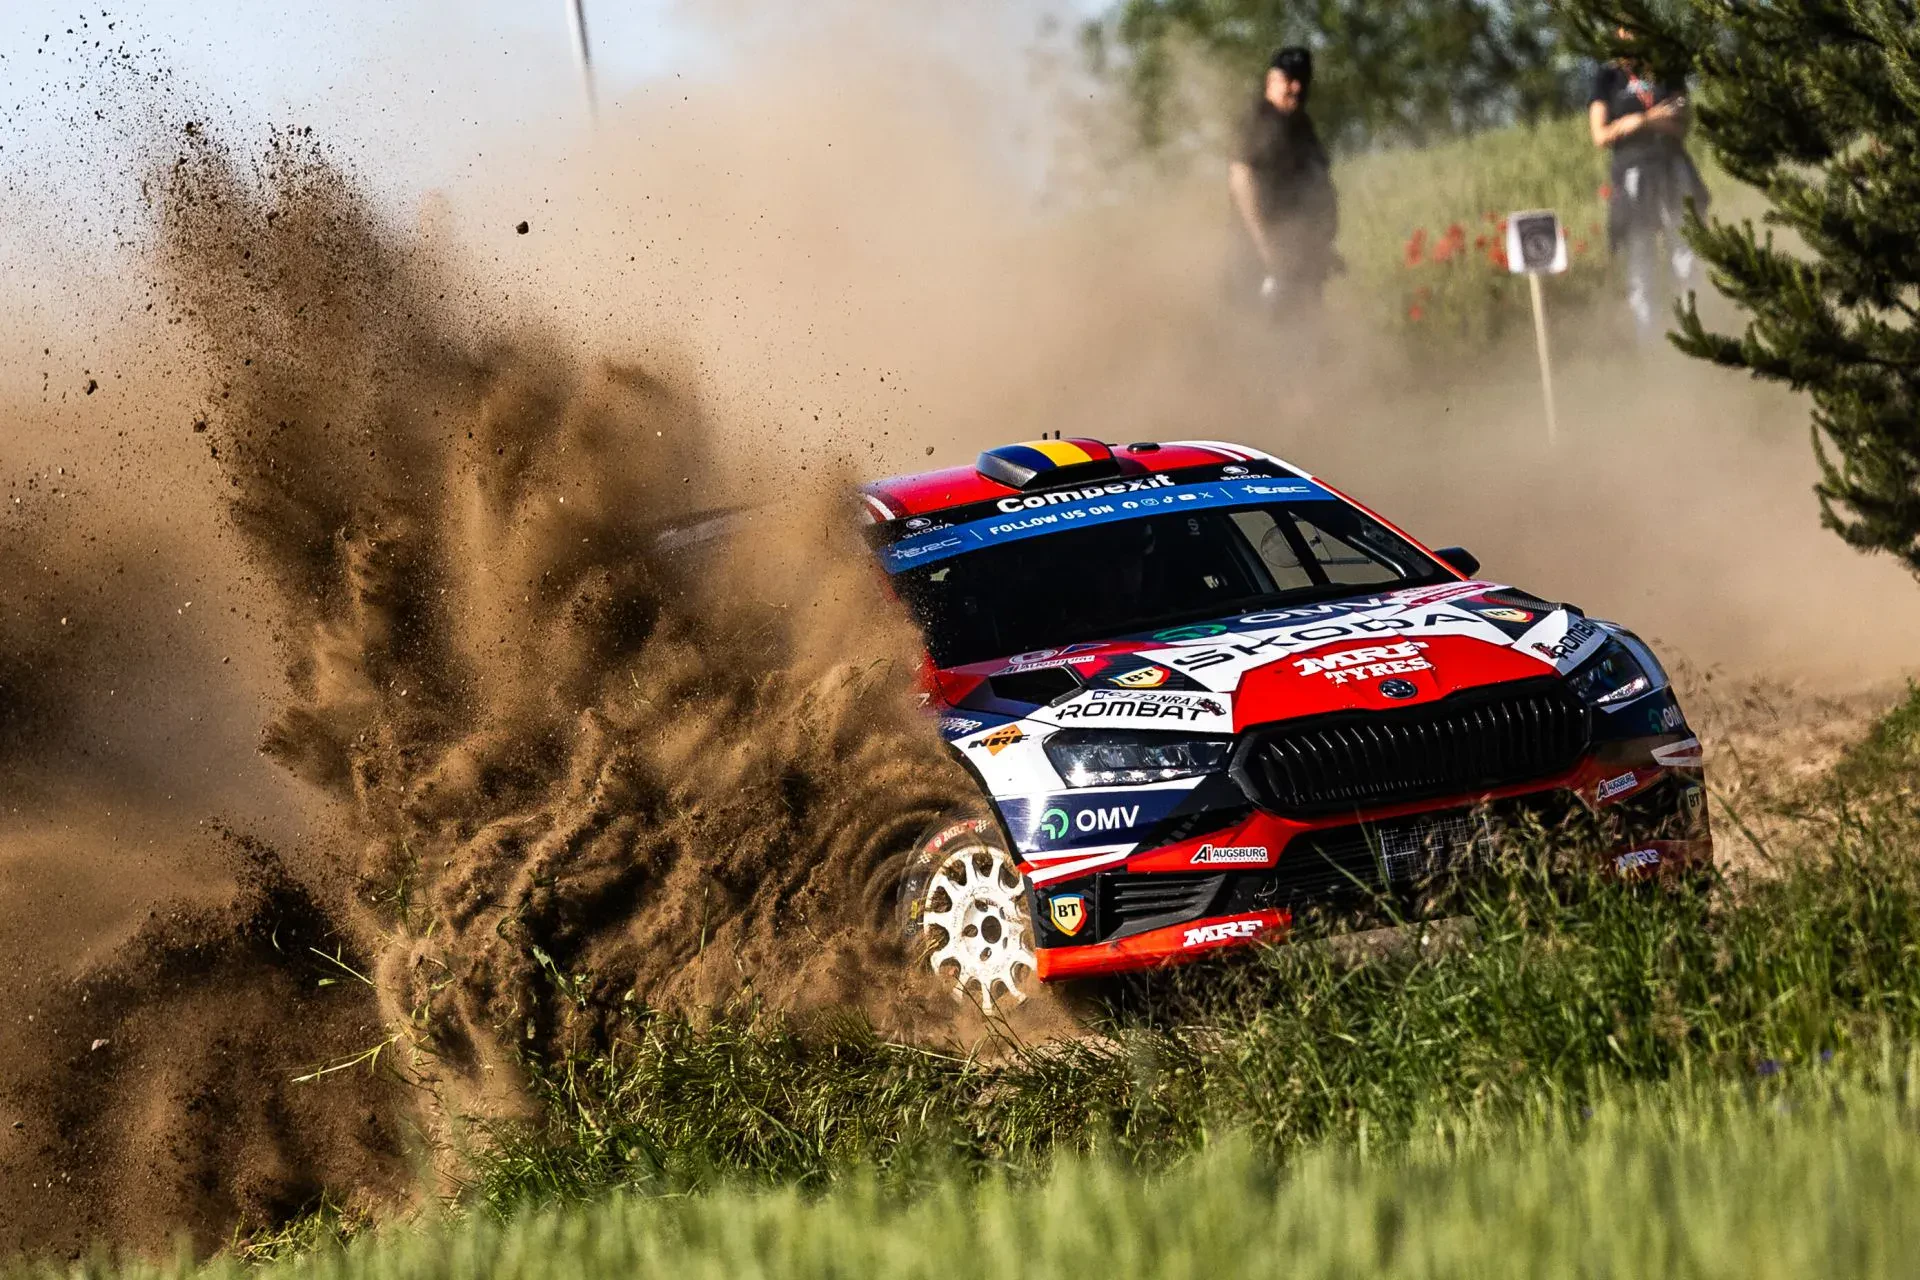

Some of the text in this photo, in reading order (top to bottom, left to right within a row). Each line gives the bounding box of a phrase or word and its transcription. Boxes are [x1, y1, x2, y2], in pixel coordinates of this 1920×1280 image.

[997, 474, 1175, 513] Compexit
[990, 504, 1115, 535] FOLLOW US ON
[1239, 598, 1382, 623] OMV
[1292, 640, 1430, 677] MRF
[1126, 670, 1154, 684] BT
[1323, 657, 1434, 685] TYRES
[1055, 701, 1210, 721] ROMBAT
[1156, 695, 1192, 706] NRA
[968, 734, 1030, 749] NRF
[1688, 793, 1700, 808] BT
[1076, 805, 1140, 832] OMV
[1213, 848, 1266, 858] AUGSBURG
[1057, 903, 1079, 917] BT
[1183, 919, 1264, 947] MRF
